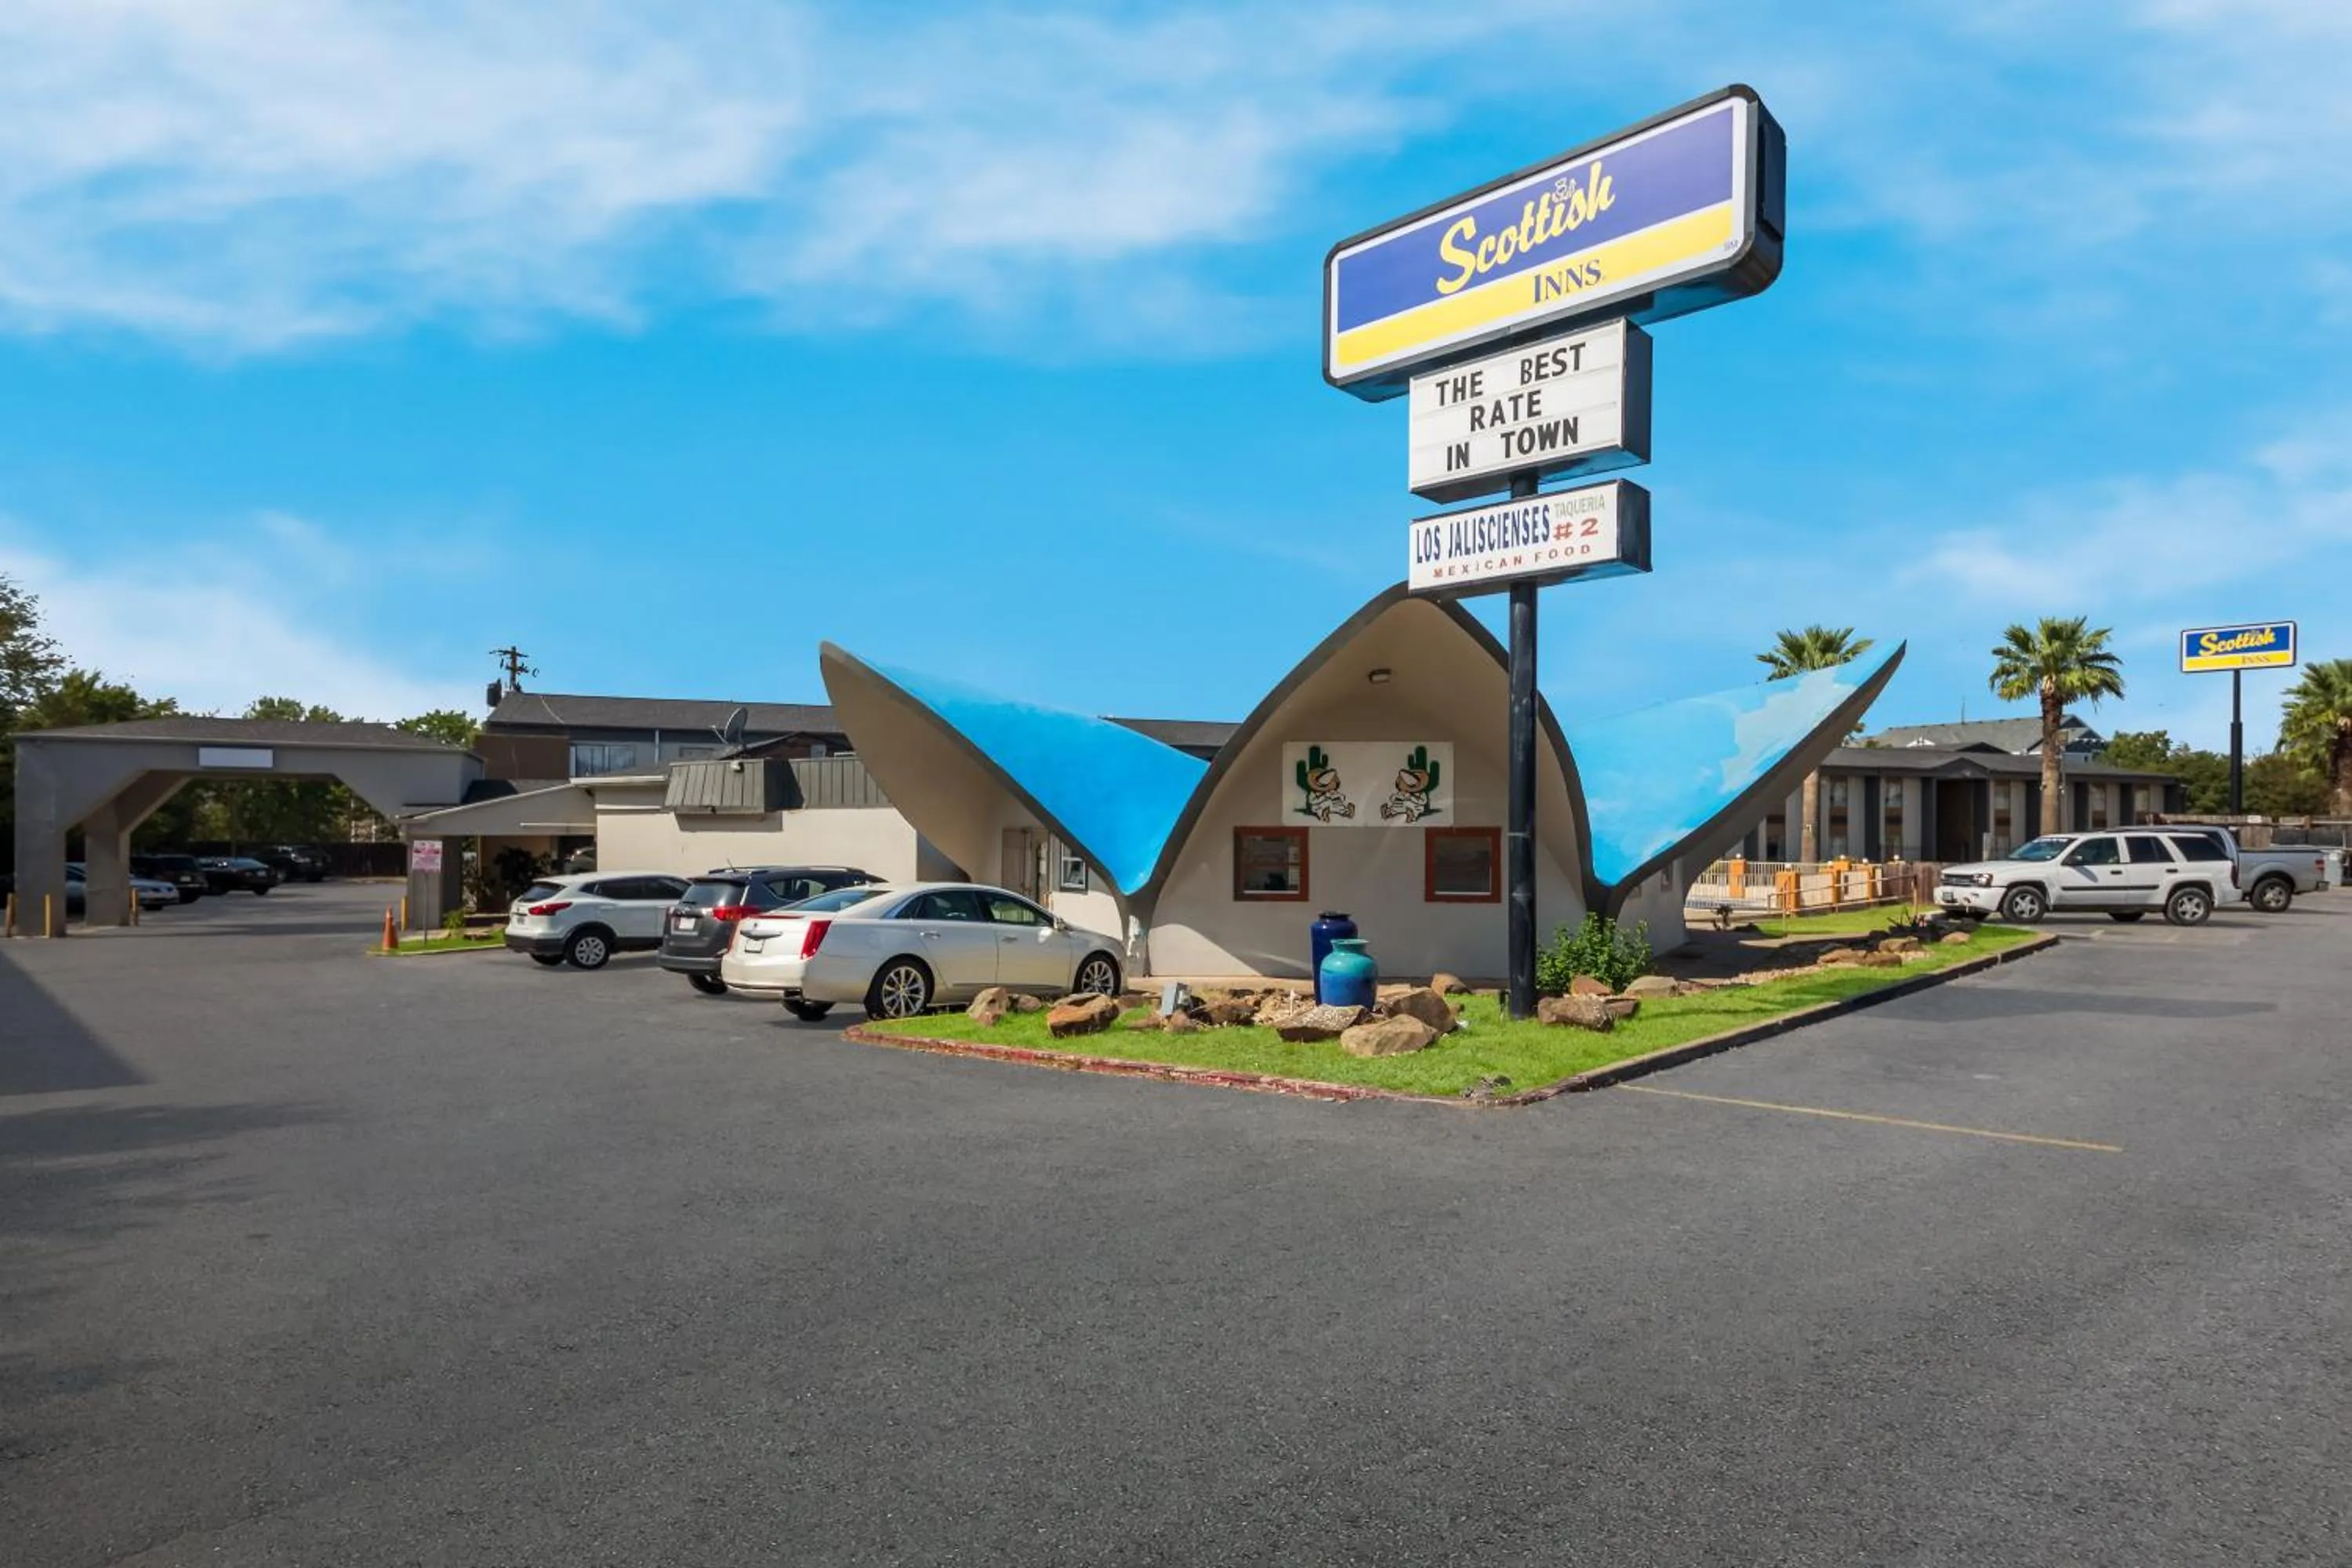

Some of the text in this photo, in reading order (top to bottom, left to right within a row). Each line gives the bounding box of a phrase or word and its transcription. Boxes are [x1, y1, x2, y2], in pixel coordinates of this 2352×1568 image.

[1436, 162, 1615, 295] Scottish
[1534, 259, 1602, 303] INNS
[1436, 342, 1587, 406] THE BEST
[1469, 389, 1542, 432] RATE
[1446, 416, 1579, 472] IN TOWN
[1553, 494, 1606, 518] TAQUERIA
[1416, 504, 1551, 564] LOS JALISCIENSES
[1432, 544, 1591, 579] MEXICAN FOOD
[2198, 627, 2275, 657] Scottish
